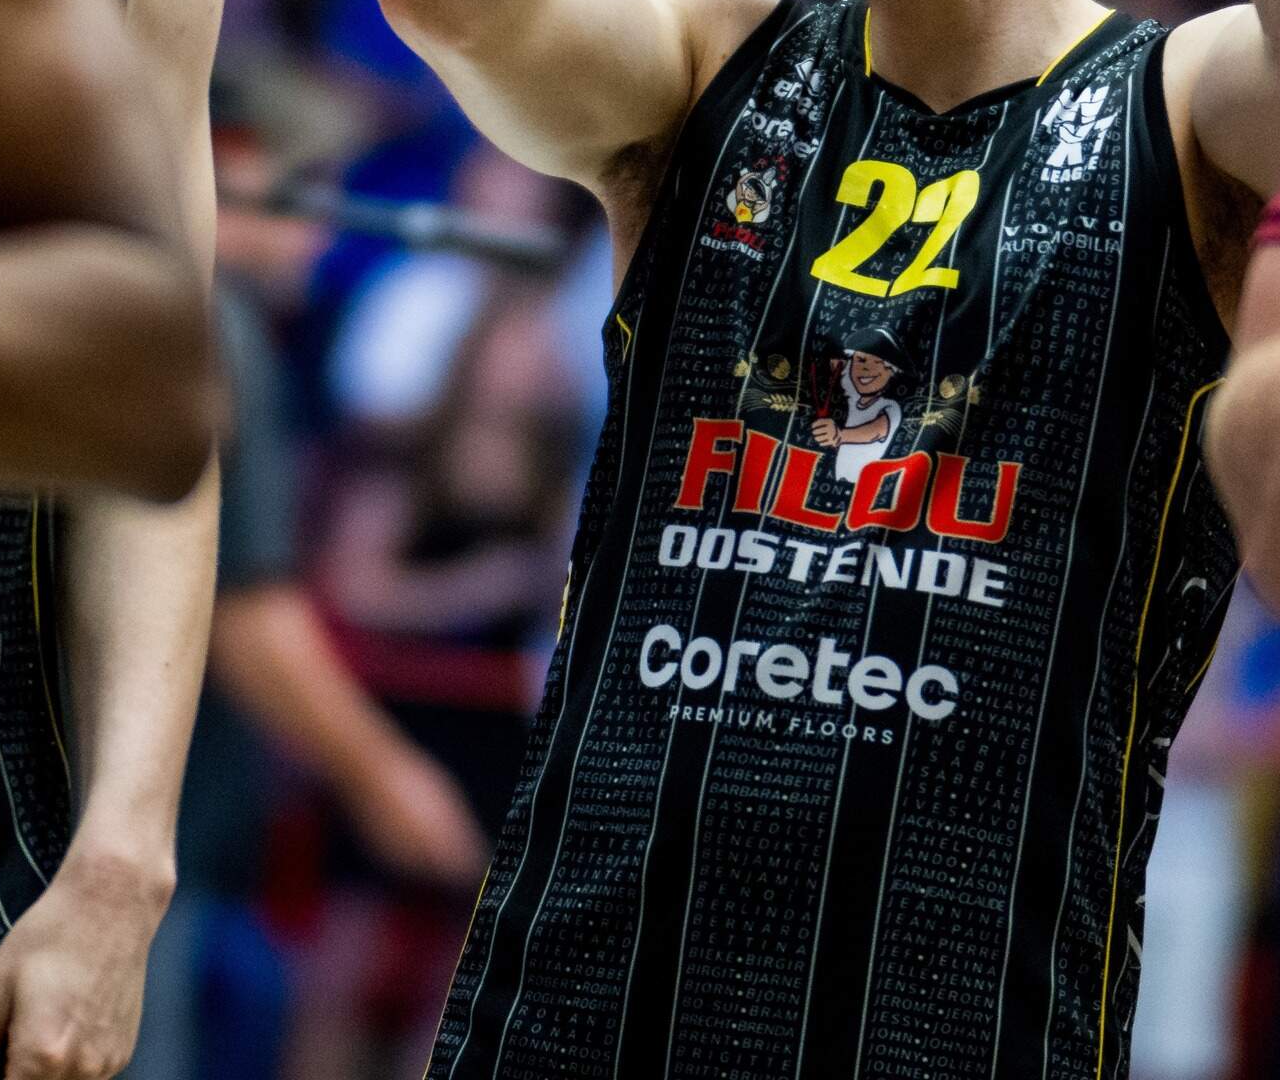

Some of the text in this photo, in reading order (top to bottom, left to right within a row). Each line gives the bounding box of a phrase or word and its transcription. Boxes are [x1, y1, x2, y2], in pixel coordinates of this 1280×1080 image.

[1040, 155, 1099, 183] LEAGE
[809, 160, 980, 298] 22
[673, 416, 1022, 544] FILOU
[657, 523, 1012, 608] OOSTENDE
[638, 622, 958, 721] Coretec
[669, 705, 773, 730] PREMIUM
[787, 716, 894, 745] FLOORS
